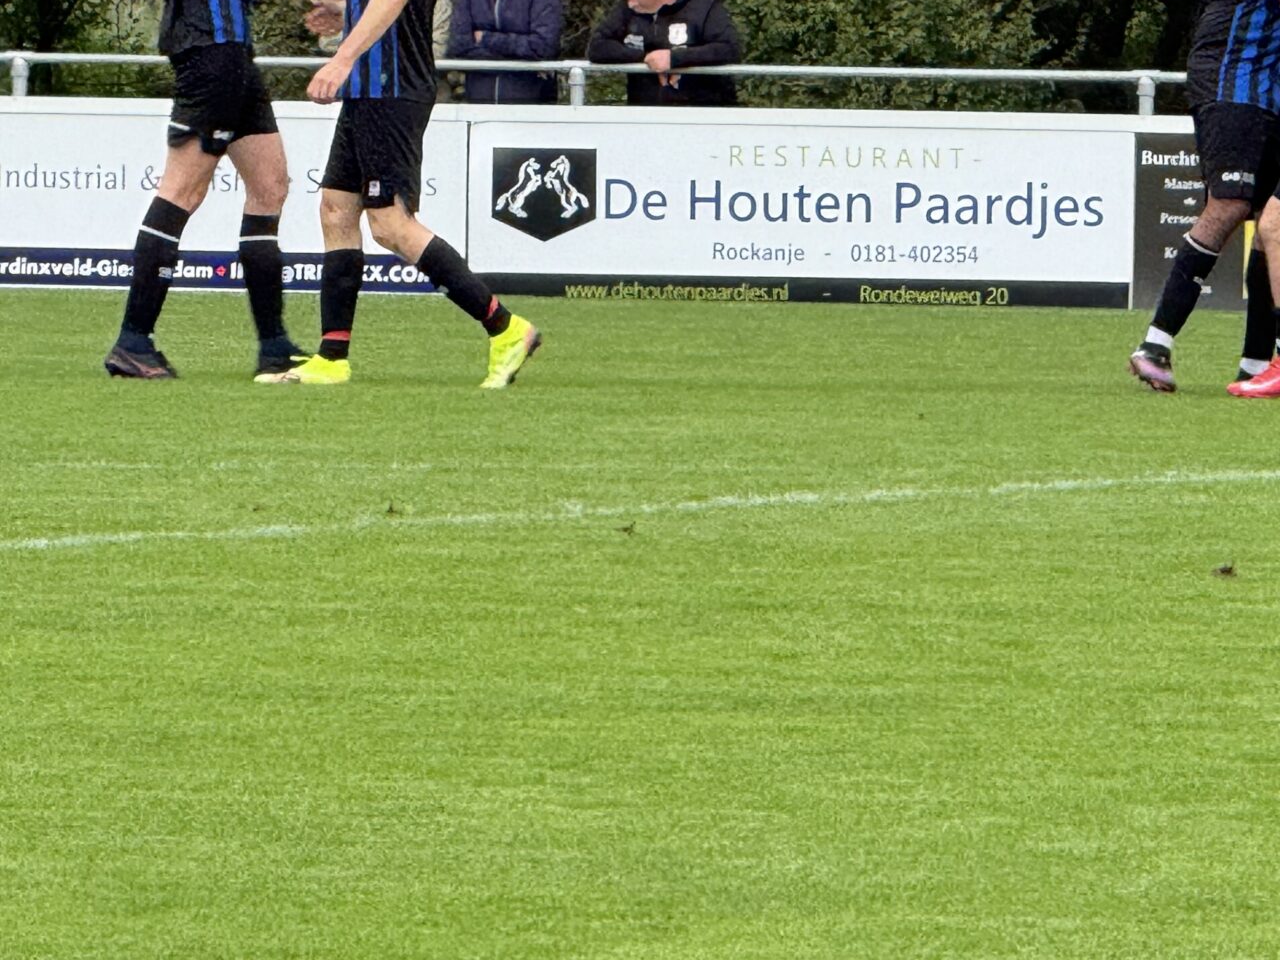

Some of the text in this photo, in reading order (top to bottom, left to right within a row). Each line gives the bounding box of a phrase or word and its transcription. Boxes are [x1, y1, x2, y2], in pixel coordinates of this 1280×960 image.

[1141, 150, 1200, 166] Burcht
[0, 163, 161, 191] ndustrial &
[605, 178, 1104, 239] De Houten Paardjes
[712, 242, 805, 266] Rockanje
[850, 244, 979, 264] 0181-402354
[860, 285, 981, 306] Rondeweiweg
[985, 287, 1009, 305] 20
